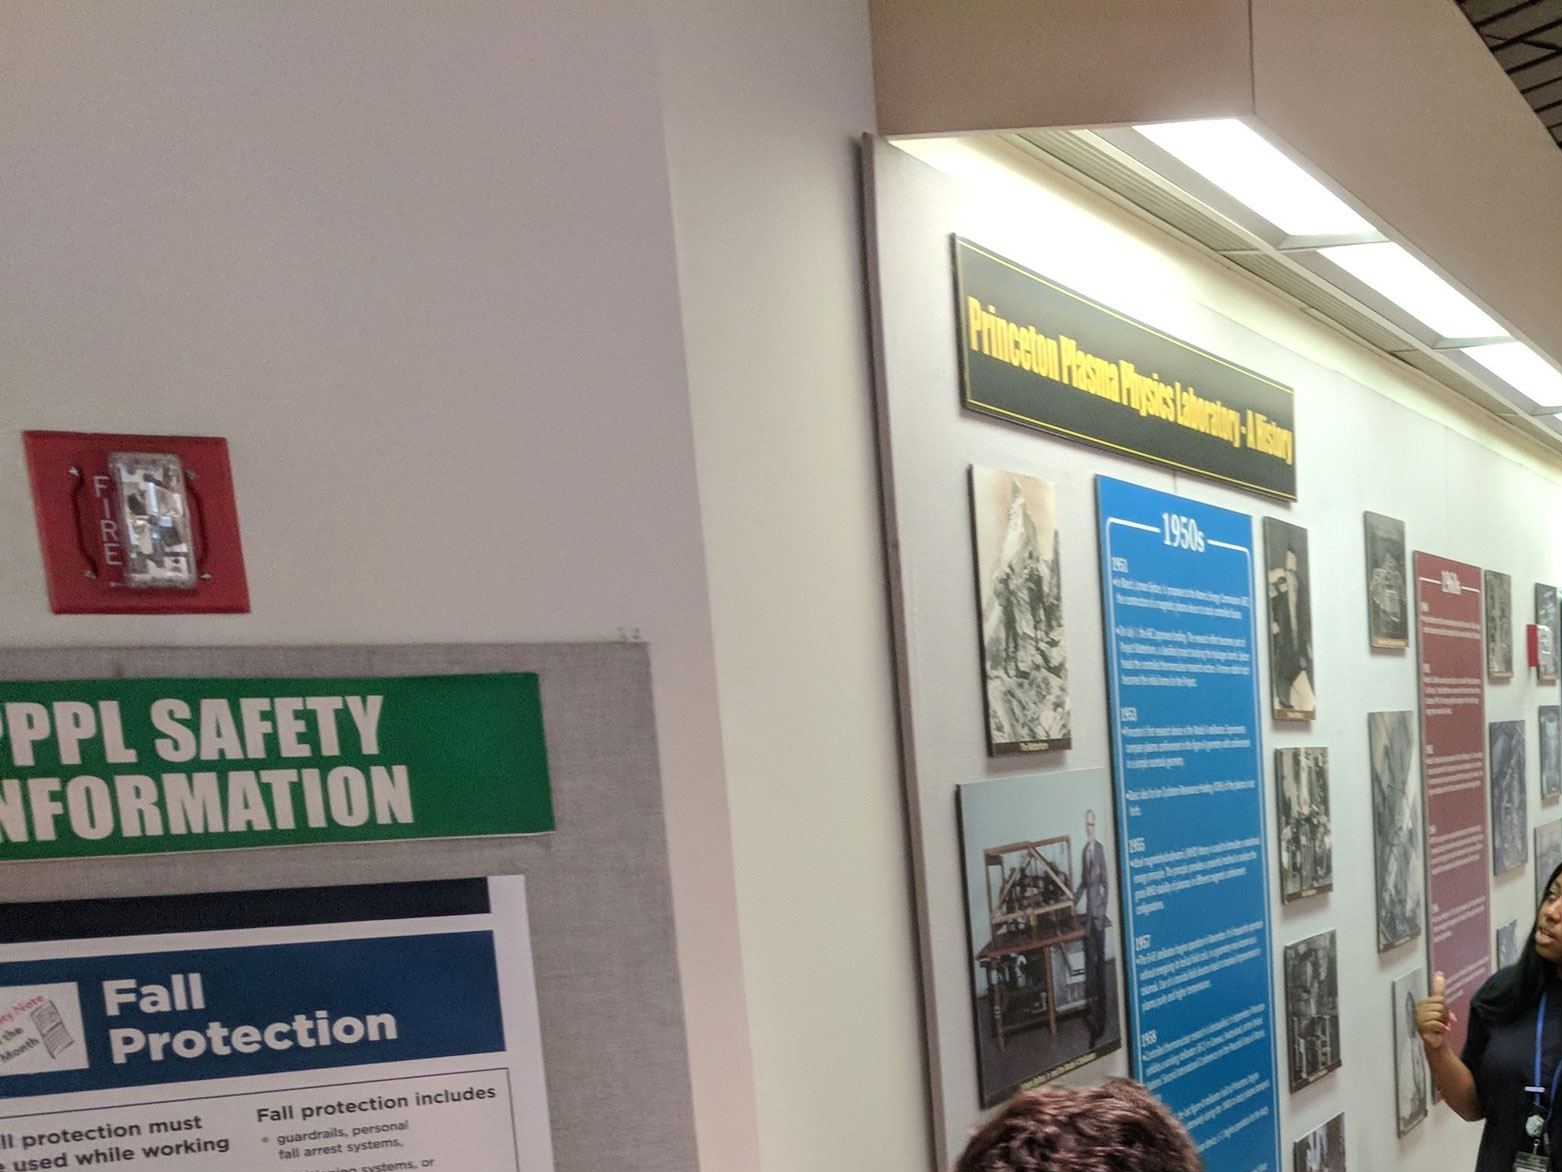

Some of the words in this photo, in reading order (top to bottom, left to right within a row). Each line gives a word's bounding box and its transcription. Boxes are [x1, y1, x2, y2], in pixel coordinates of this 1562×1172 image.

[967, 296, 1060, 384] Princeton
[1060, 335, 1119, 401] Plasma
[1119, 360, 1174, 422] Physics
[1175, 382, 1241, 448] Laboratory
[93, 475, 123, 566] FIRE
[1162, 512, 1205, 552] 1950s
[0, 697, 138, 767] PPL
[150, 695, 384, 763] SAFETY
[103, 973, 205, 1016] Fall
[109, 1010, 398, 1064] Protection
[256, 1104, 294, 1123] Fall
[301, 1095, 409, 1121] protection
[415, 1086, 497, 1106] includes
[22, 1123, 142, 1150] protection
[149, 1115, 203, 1134] must
[352, 1120, 409, 1137] personal
[13, 1153, 68, 1172] used
[75, 1147, 135, 1166] while
[142, 1137, 230, 1159] working
[279, 1148, 300, 1160] fall
[303, 1143, 343, 1157] arrest
[421, 1158, 435, 1168] or
